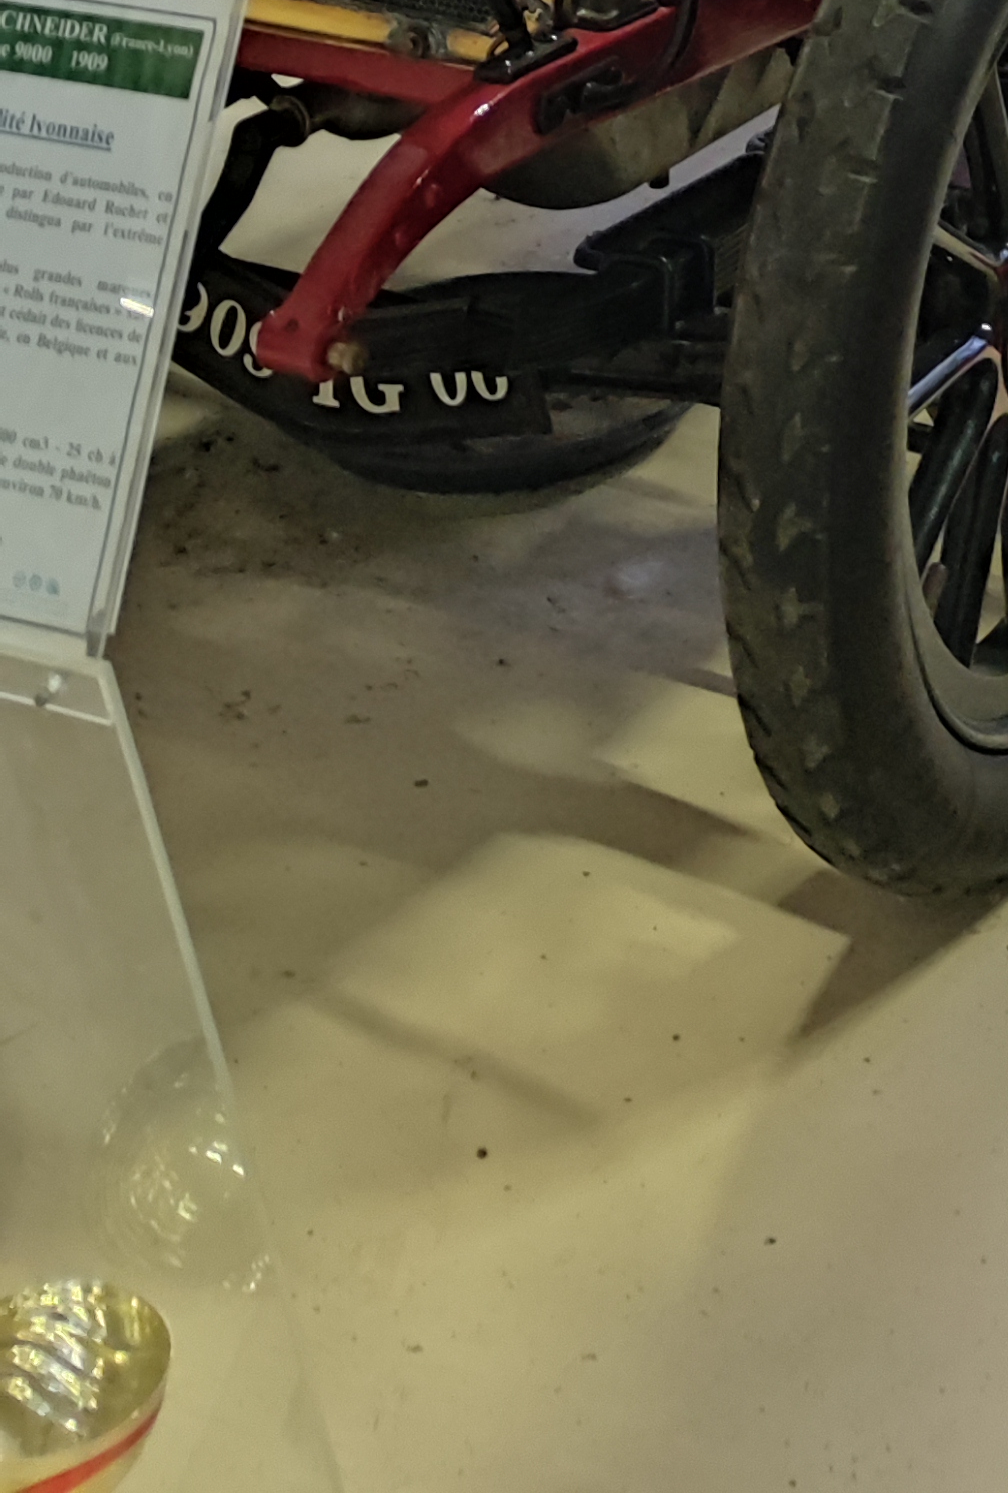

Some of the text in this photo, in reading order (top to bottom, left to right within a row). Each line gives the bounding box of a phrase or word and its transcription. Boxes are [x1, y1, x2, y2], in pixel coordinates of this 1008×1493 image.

[0, 9, 108, 46] CHNEIDER
[14, 40, 53, 65] 9000
[71, 49, 109, 71] 1909
[29, 113, 115, 147] lyonnaise
[12, 187, 34, 201] par
[105, 199, 148, 220] Rochet
[155, 212, 168, 225] et
[158, 190, 173, 203] en
[6, 206, 163, 246] distingua par l'extrême
[14, 283, 43, 303] Rolls
[33, 268, 82, 288] grandes
[50, 313, 71, 330] des
[75, 317, 123, 341] licences
[127, 328, 142, 345] de
[16, 333, 31, 345] en
[37, 332, 91, 359] Belgique
[96, 348, 109, 360] et
[114, 352, 137, 366] aux
[13, 455, 56, 477] double
